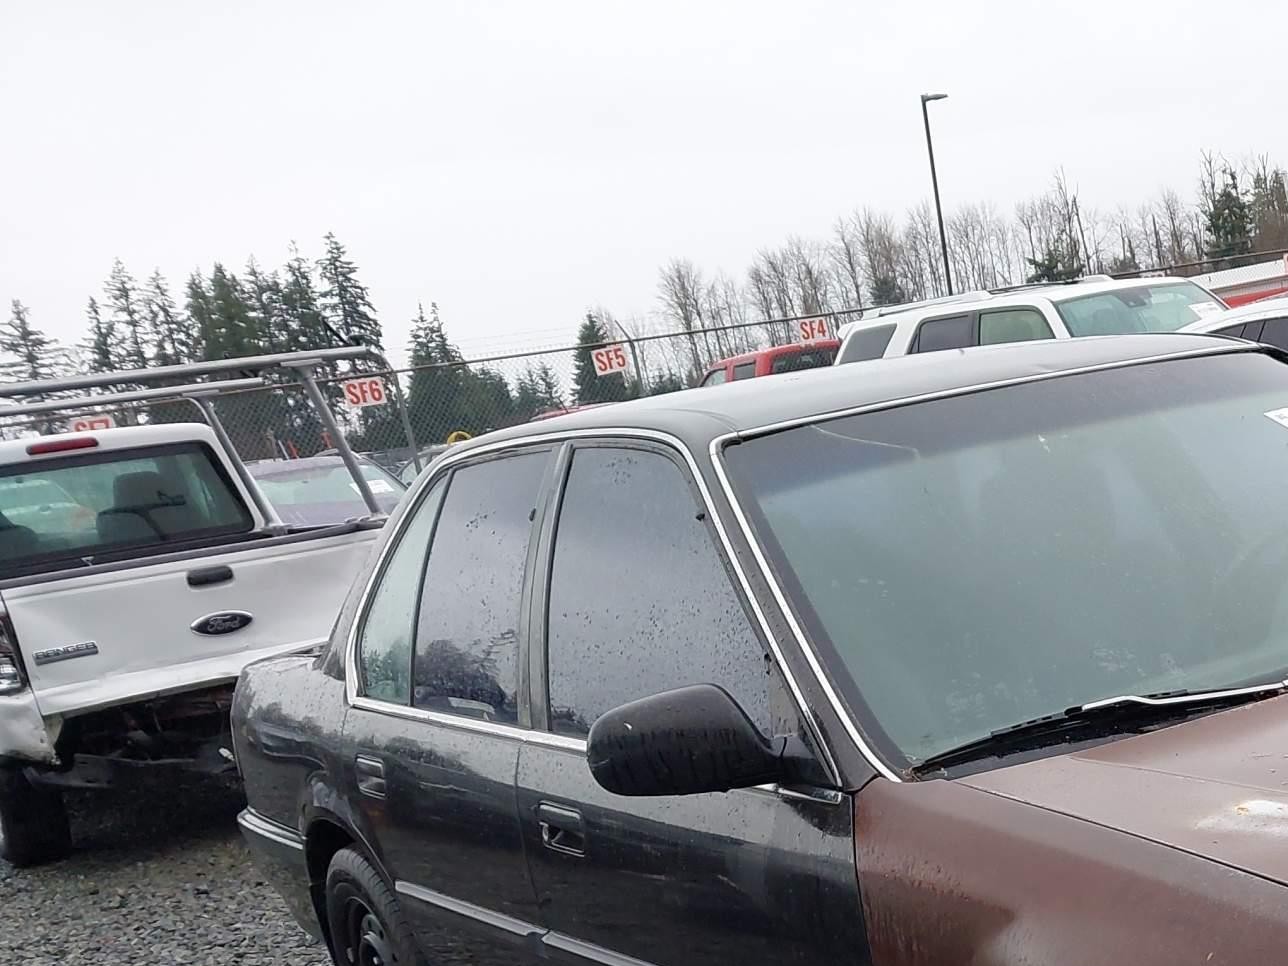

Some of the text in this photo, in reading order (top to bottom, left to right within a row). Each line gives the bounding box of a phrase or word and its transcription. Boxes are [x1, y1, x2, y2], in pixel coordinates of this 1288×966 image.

[800, 318, 827, 341] SF4
[595, 348, 627, 373] SF5
[345, 379, 383, 405] SF6
[207, 614, 242, 633] Ford
